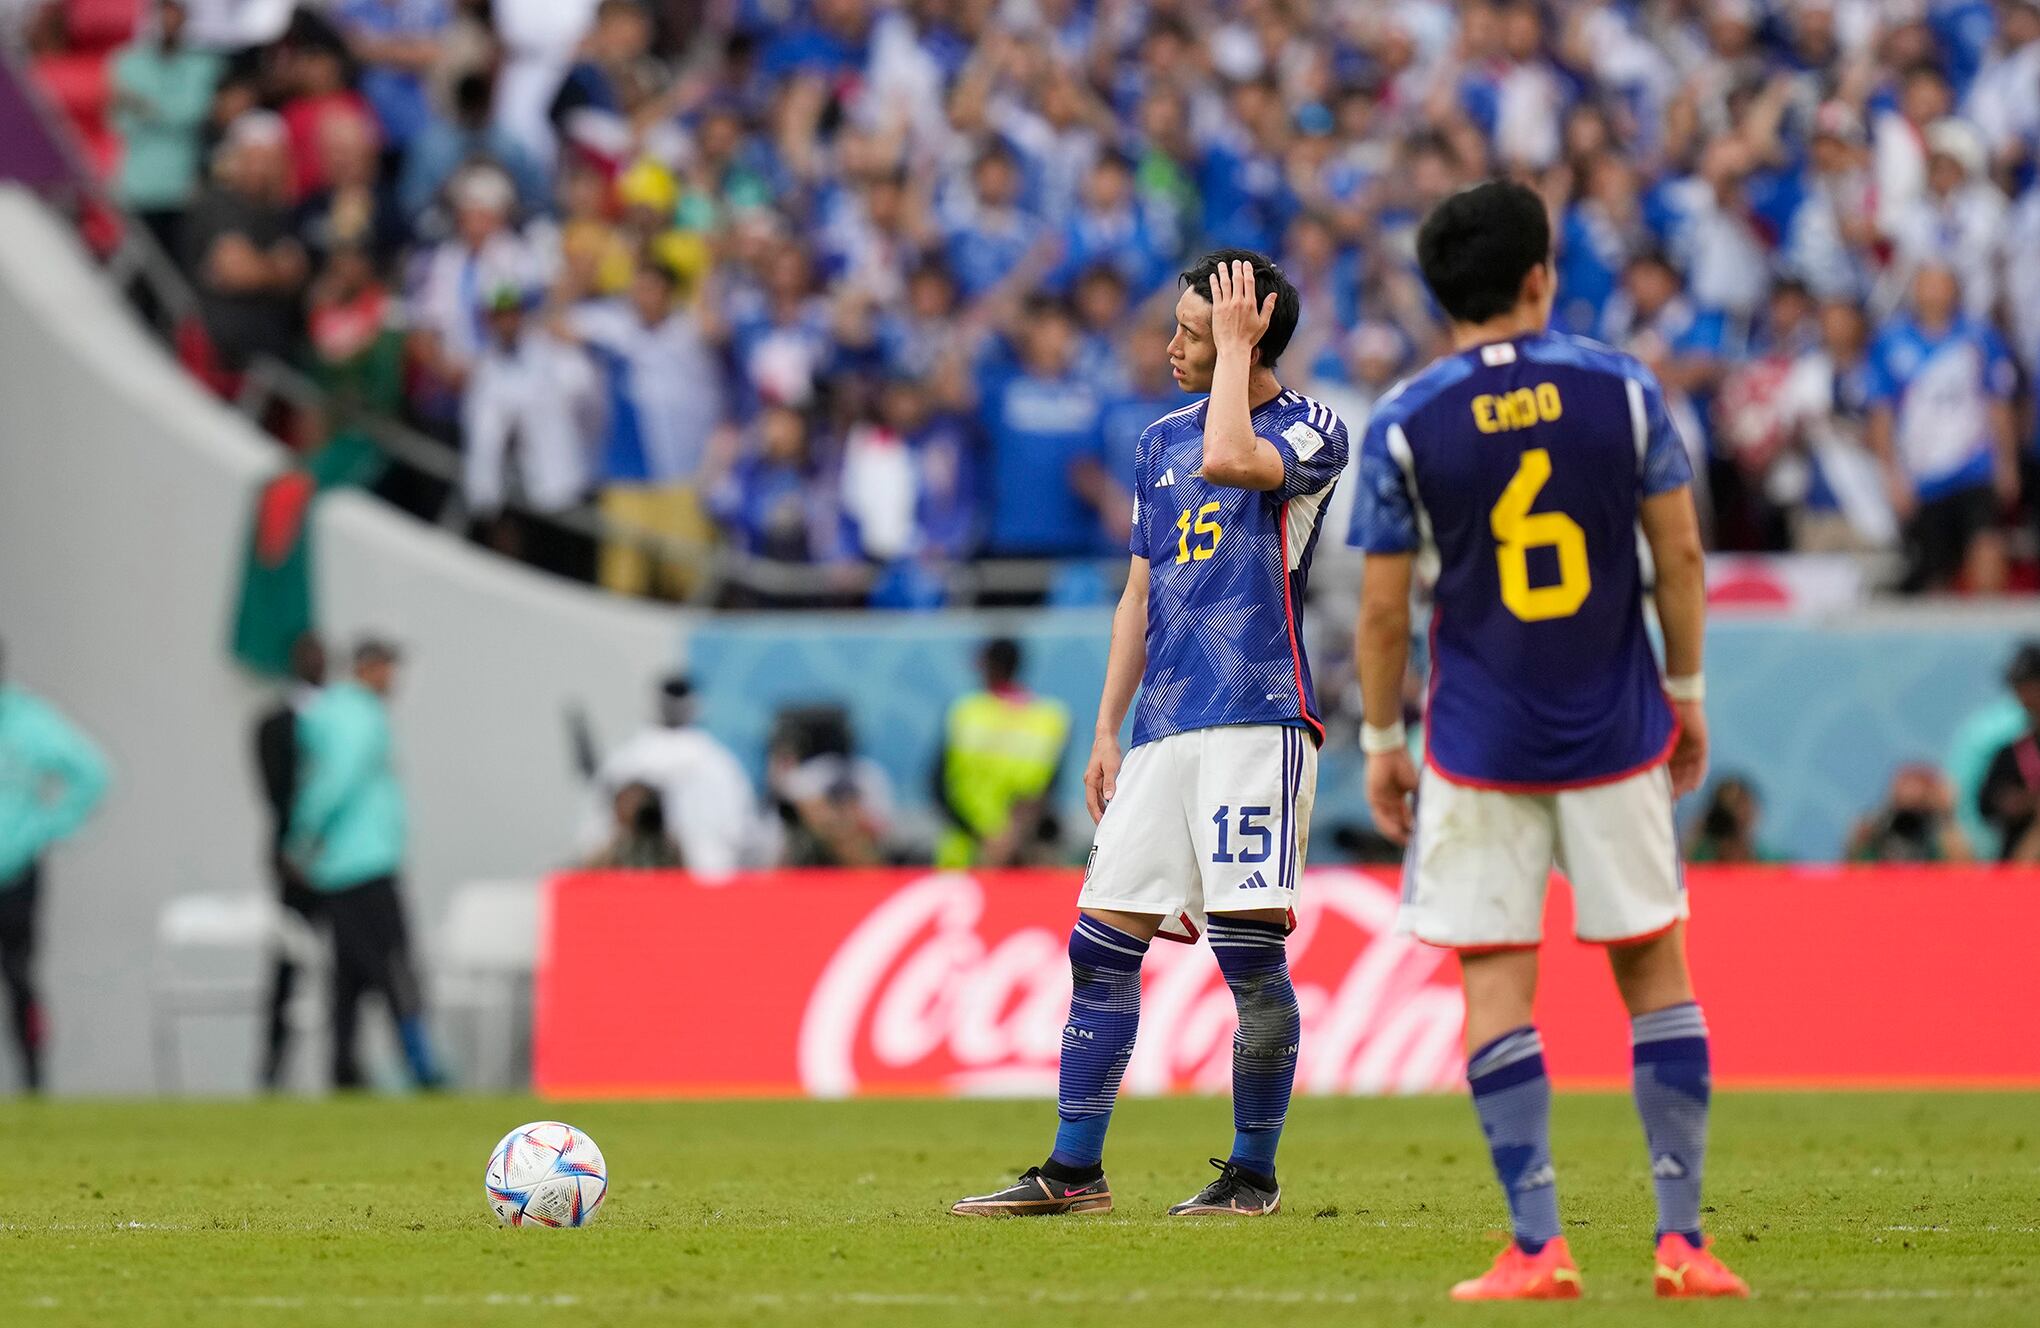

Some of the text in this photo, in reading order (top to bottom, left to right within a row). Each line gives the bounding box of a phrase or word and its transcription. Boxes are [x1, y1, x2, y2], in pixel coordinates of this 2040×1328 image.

[1471, 381, 1563, 434] ENDO
[1175, 501, 1223, 565] 15
[1489, 447, 1593, 623] 6
[1212, 805, 1272, 863] 15
[796, 868, 1466, 1098] CocCola
